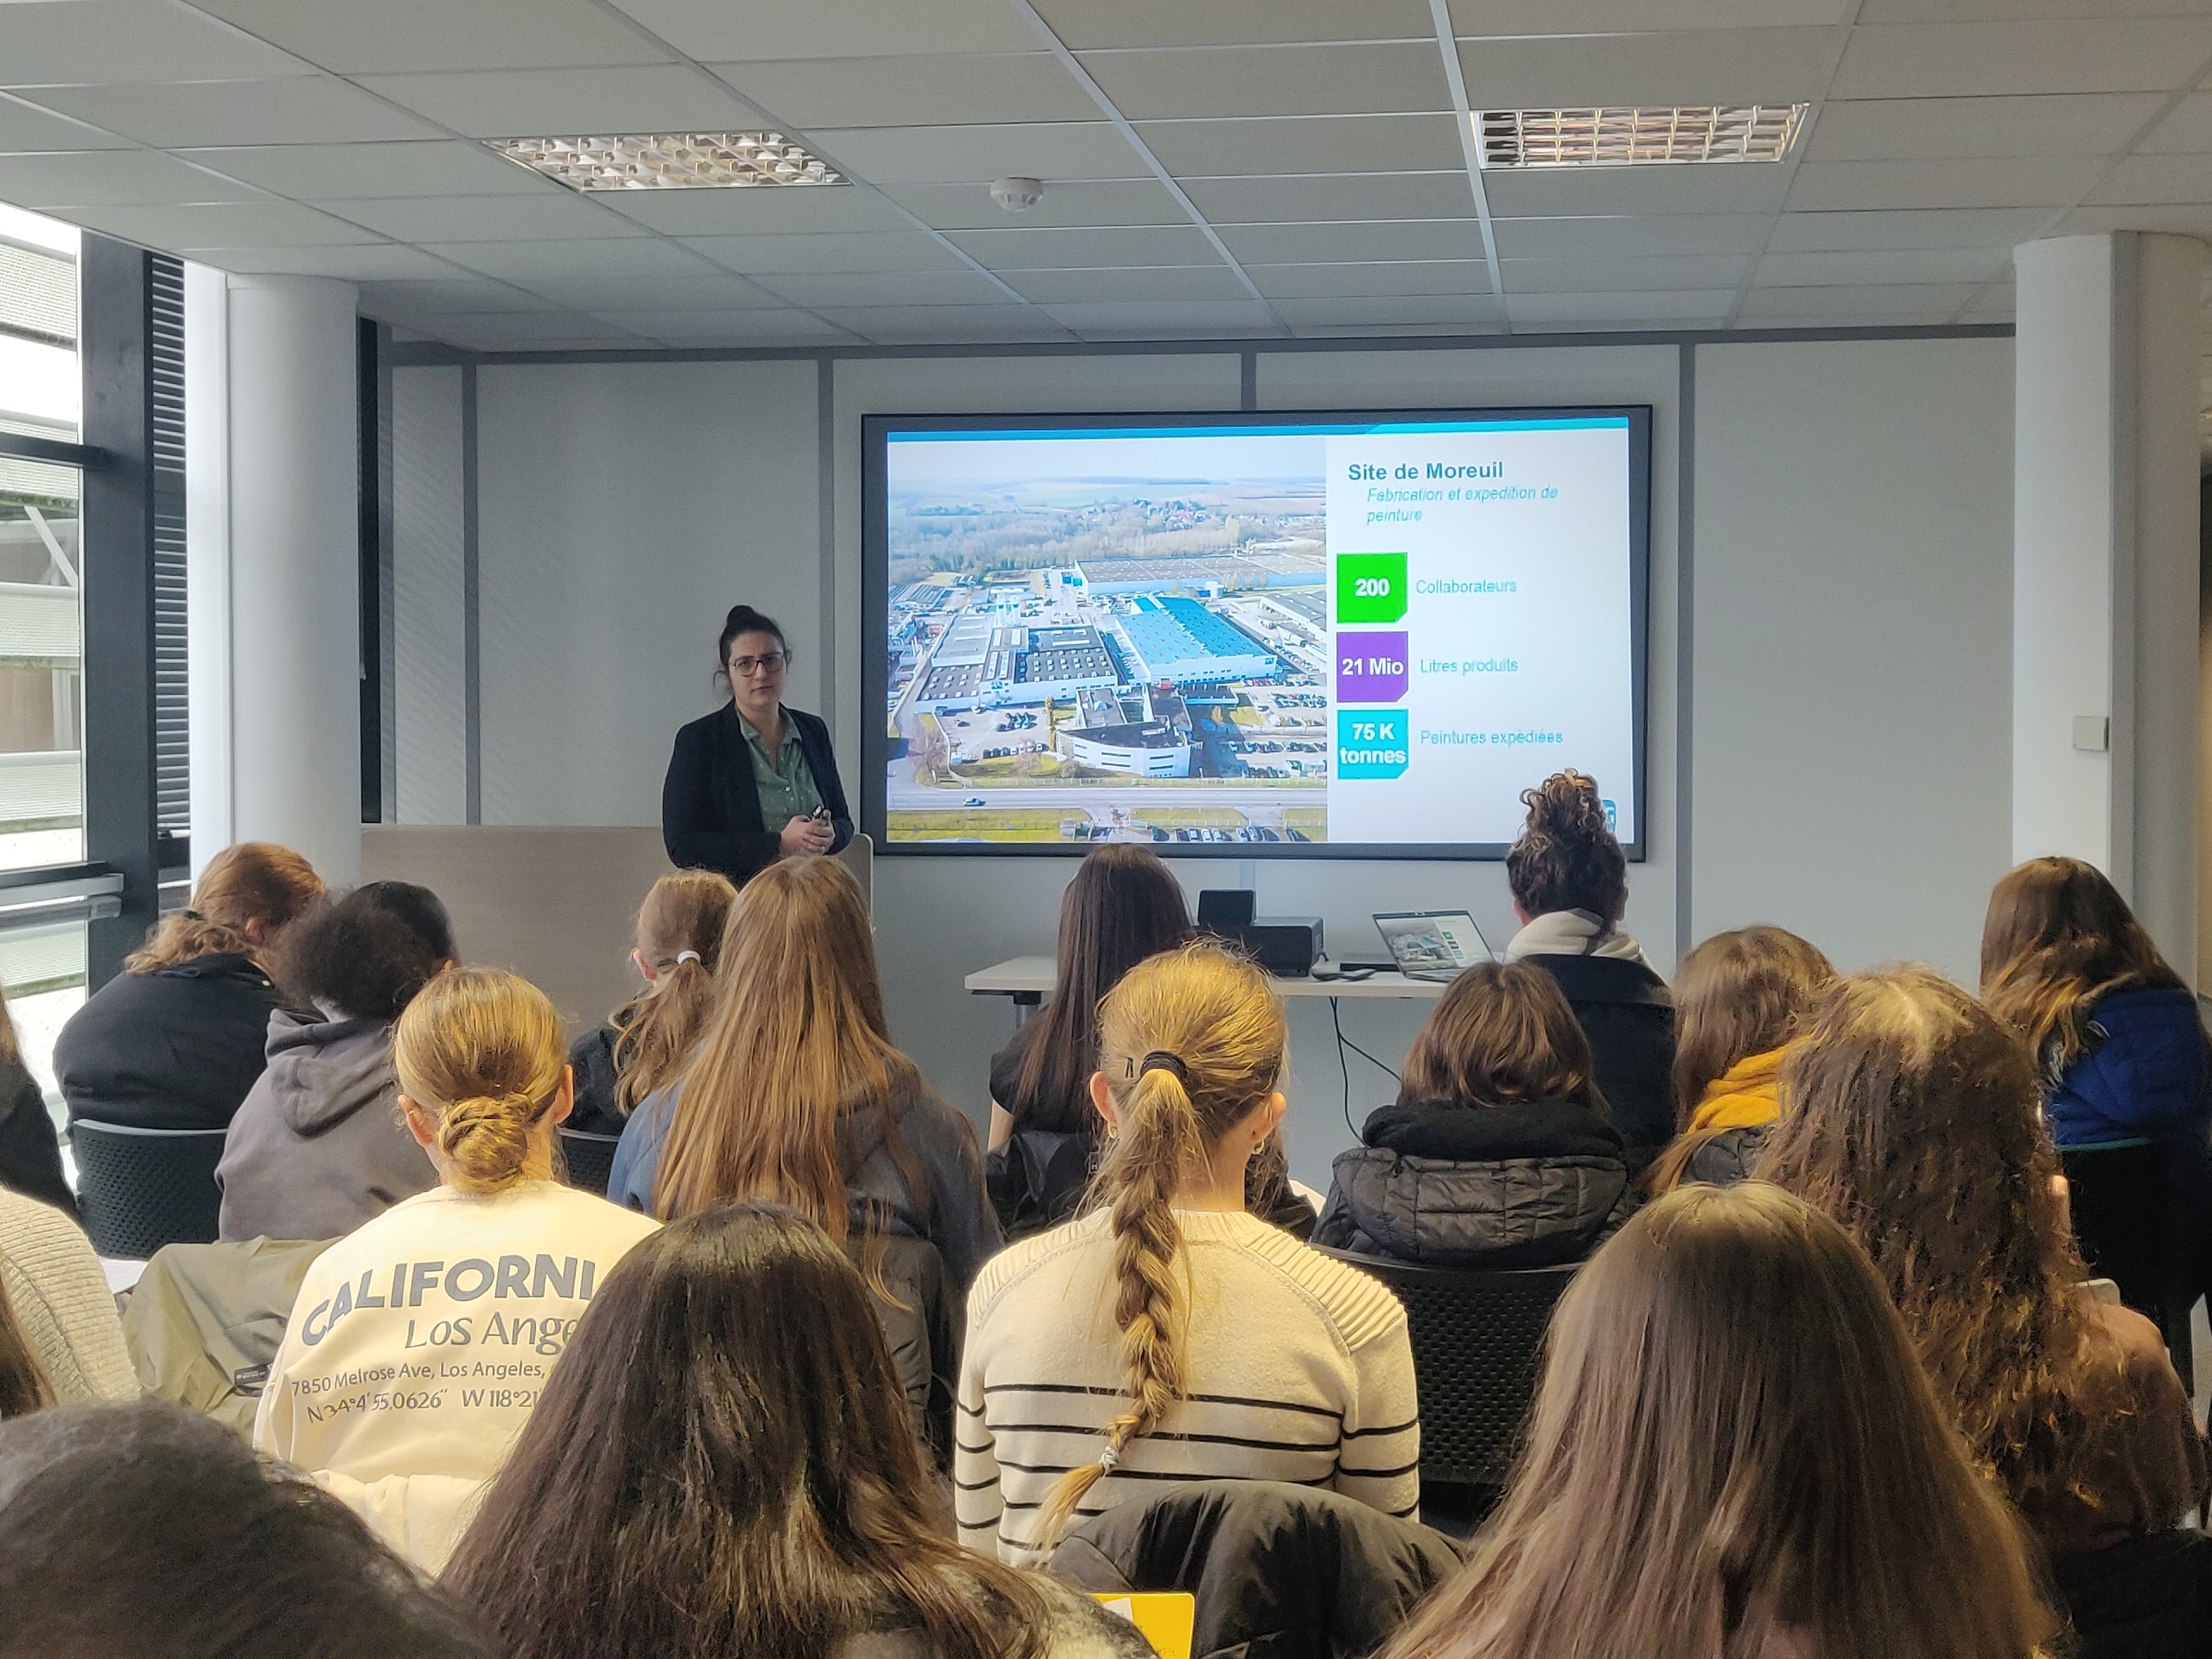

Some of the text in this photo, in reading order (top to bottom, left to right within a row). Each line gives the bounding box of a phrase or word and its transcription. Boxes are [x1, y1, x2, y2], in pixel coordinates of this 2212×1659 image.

[1348, 461, 1503, 480] Site de Moreuil
[1367, 487, 1443, 502] Fabrication
[1448, 487, 1461, 501] et
[1541, 485, 1558, 499] de
[1367, 509, 1422, 525] peinture
[1355, 578, 1390, 596] 200
[1416, 579, 1516, 594] Collaborateurs
[1342, 658, 1404, 675] 21 Mio
[1421, 658, 1518, 675] Litres produits
[1352, 723, 1395, 740] 75 K
[1421, 731, 1485, 744] Peintures
[1340, 747, 1406, 764] tonnes
[301, 1254, 595, 1346] CALIFORNI
[405, 1317, 473, 1348] Los
[292, 1360, 545, 1396] 7850 Melrose Ave, Los Angeles,
[307, 1406, 324, 1423] N
[462, 1389, 484, 1407] W
